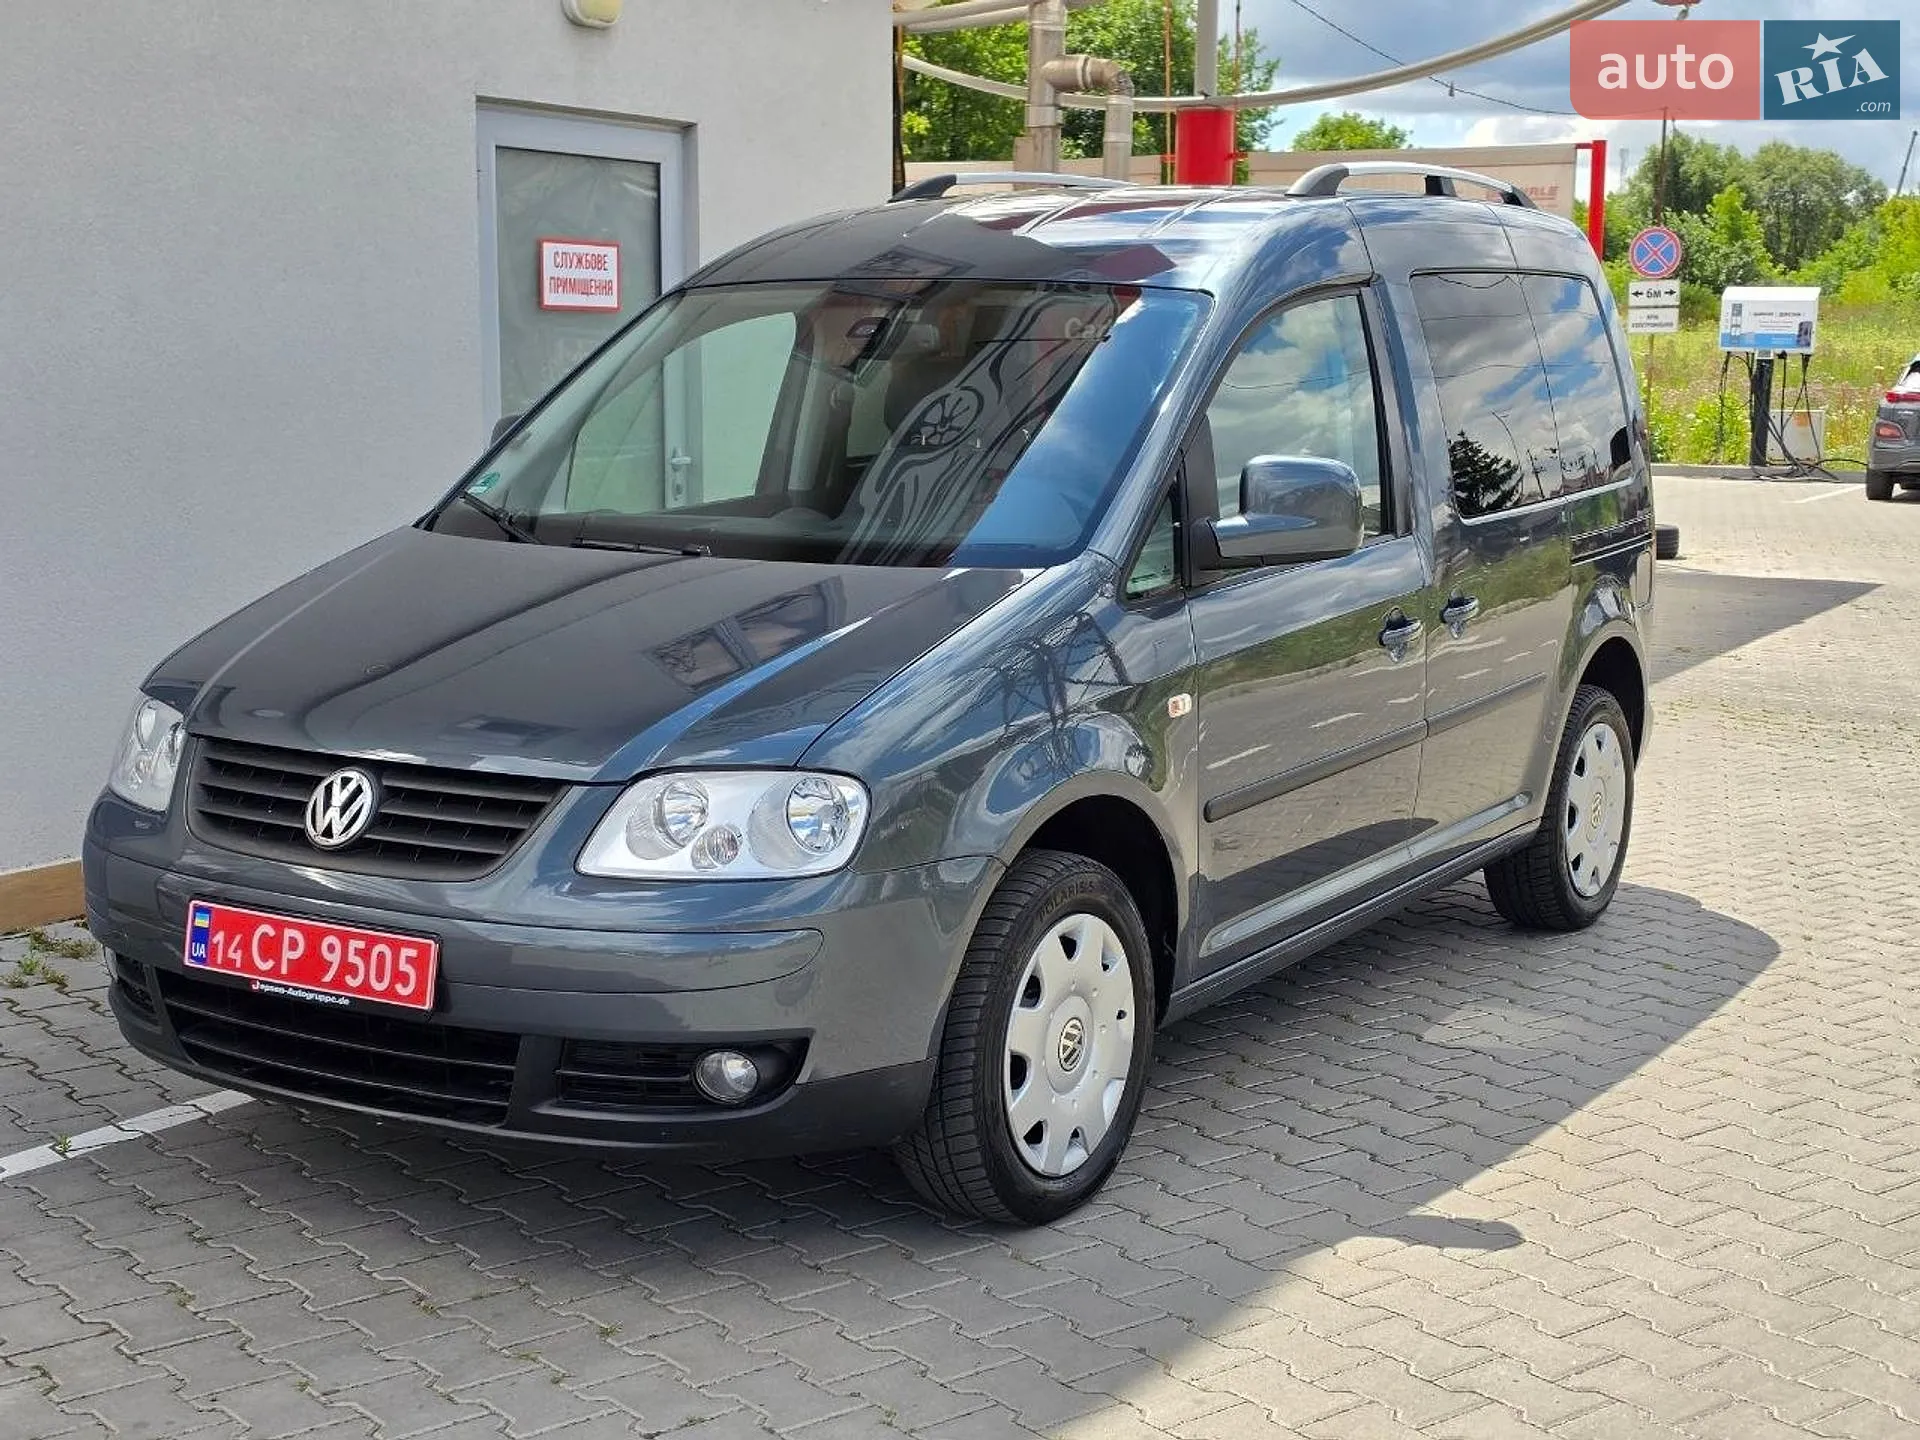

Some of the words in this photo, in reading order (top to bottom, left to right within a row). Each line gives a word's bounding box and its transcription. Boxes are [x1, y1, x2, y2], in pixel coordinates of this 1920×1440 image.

[553, 251, 609, 271] СЛУЖБОВЕ
[549, 276, 613, 297] ПРИМІЩЕННЯ
[191, 942, 207, 959] UA
[211, 930, 243, 969] 14
[252, 924, 306, 975] CP
[320, 934, 418, 996] 9505
